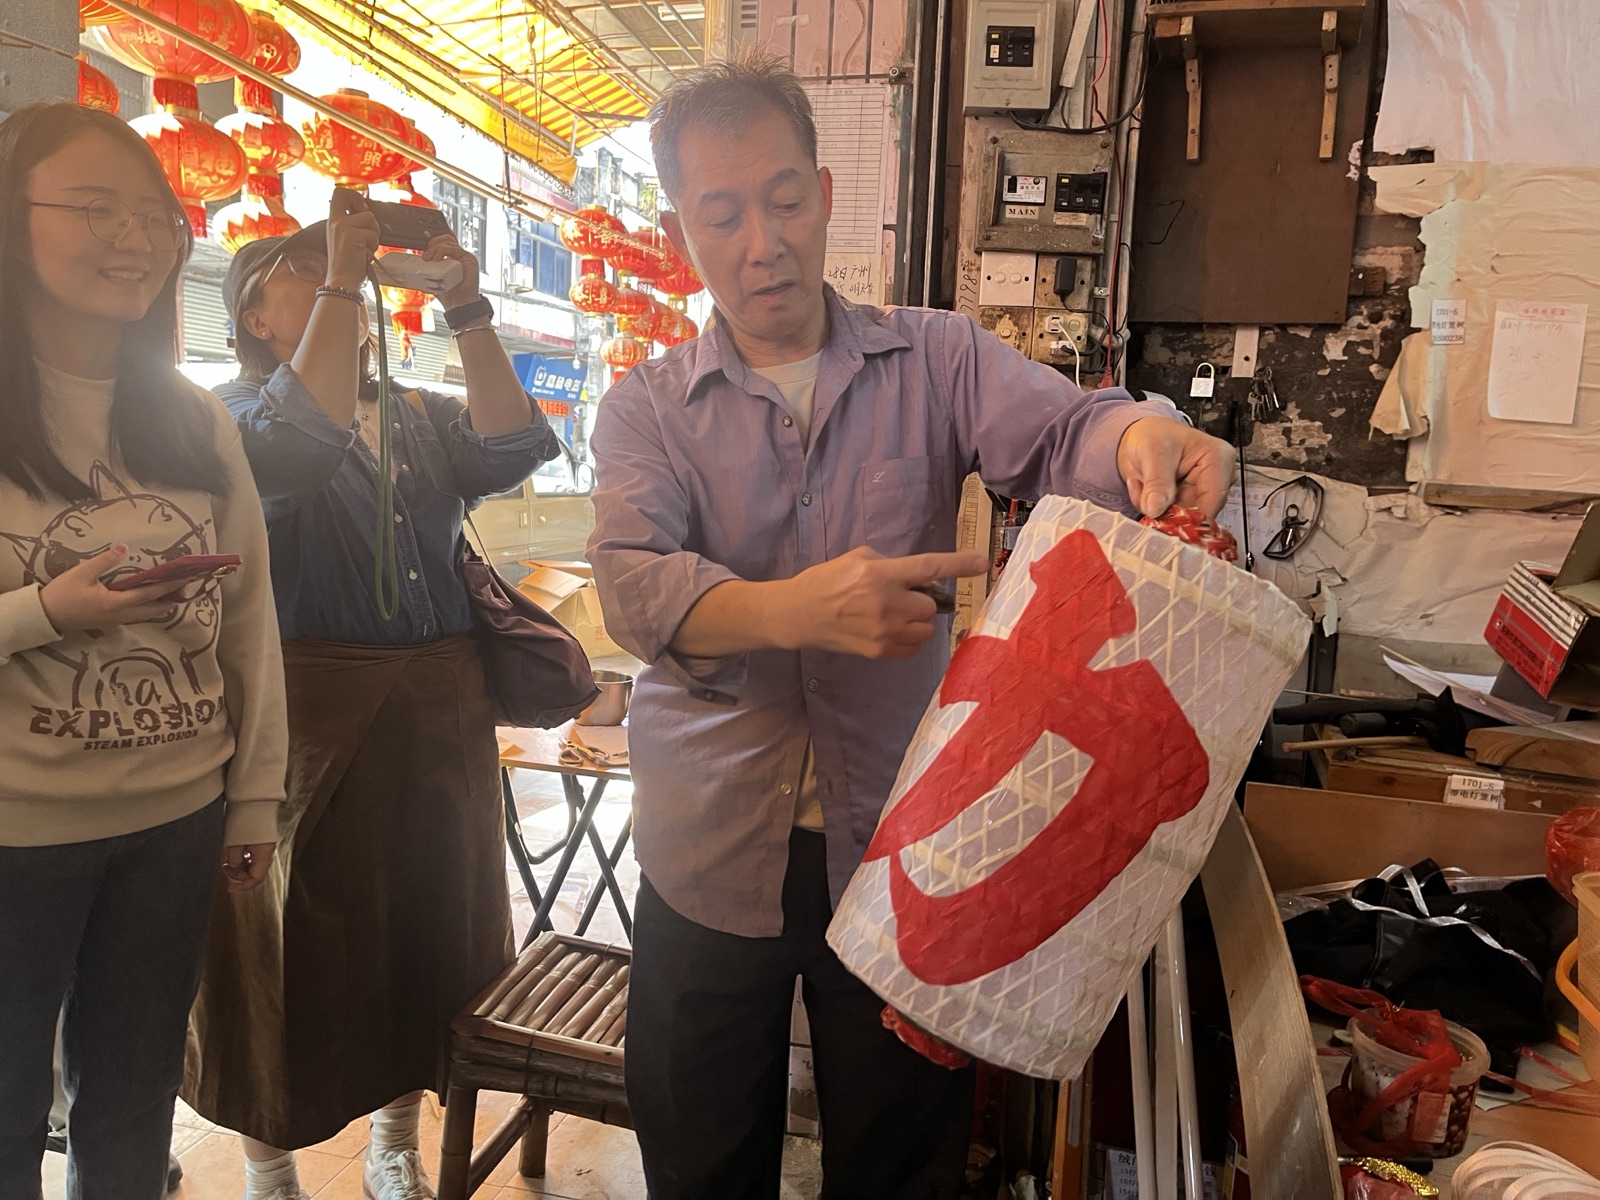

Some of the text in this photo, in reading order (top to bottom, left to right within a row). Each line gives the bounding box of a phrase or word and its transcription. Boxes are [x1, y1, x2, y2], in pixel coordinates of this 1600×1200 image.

[1008, 208, 1037, 216] MAIN
[83, 728, 199, 751] STEAM EXPLOSION
